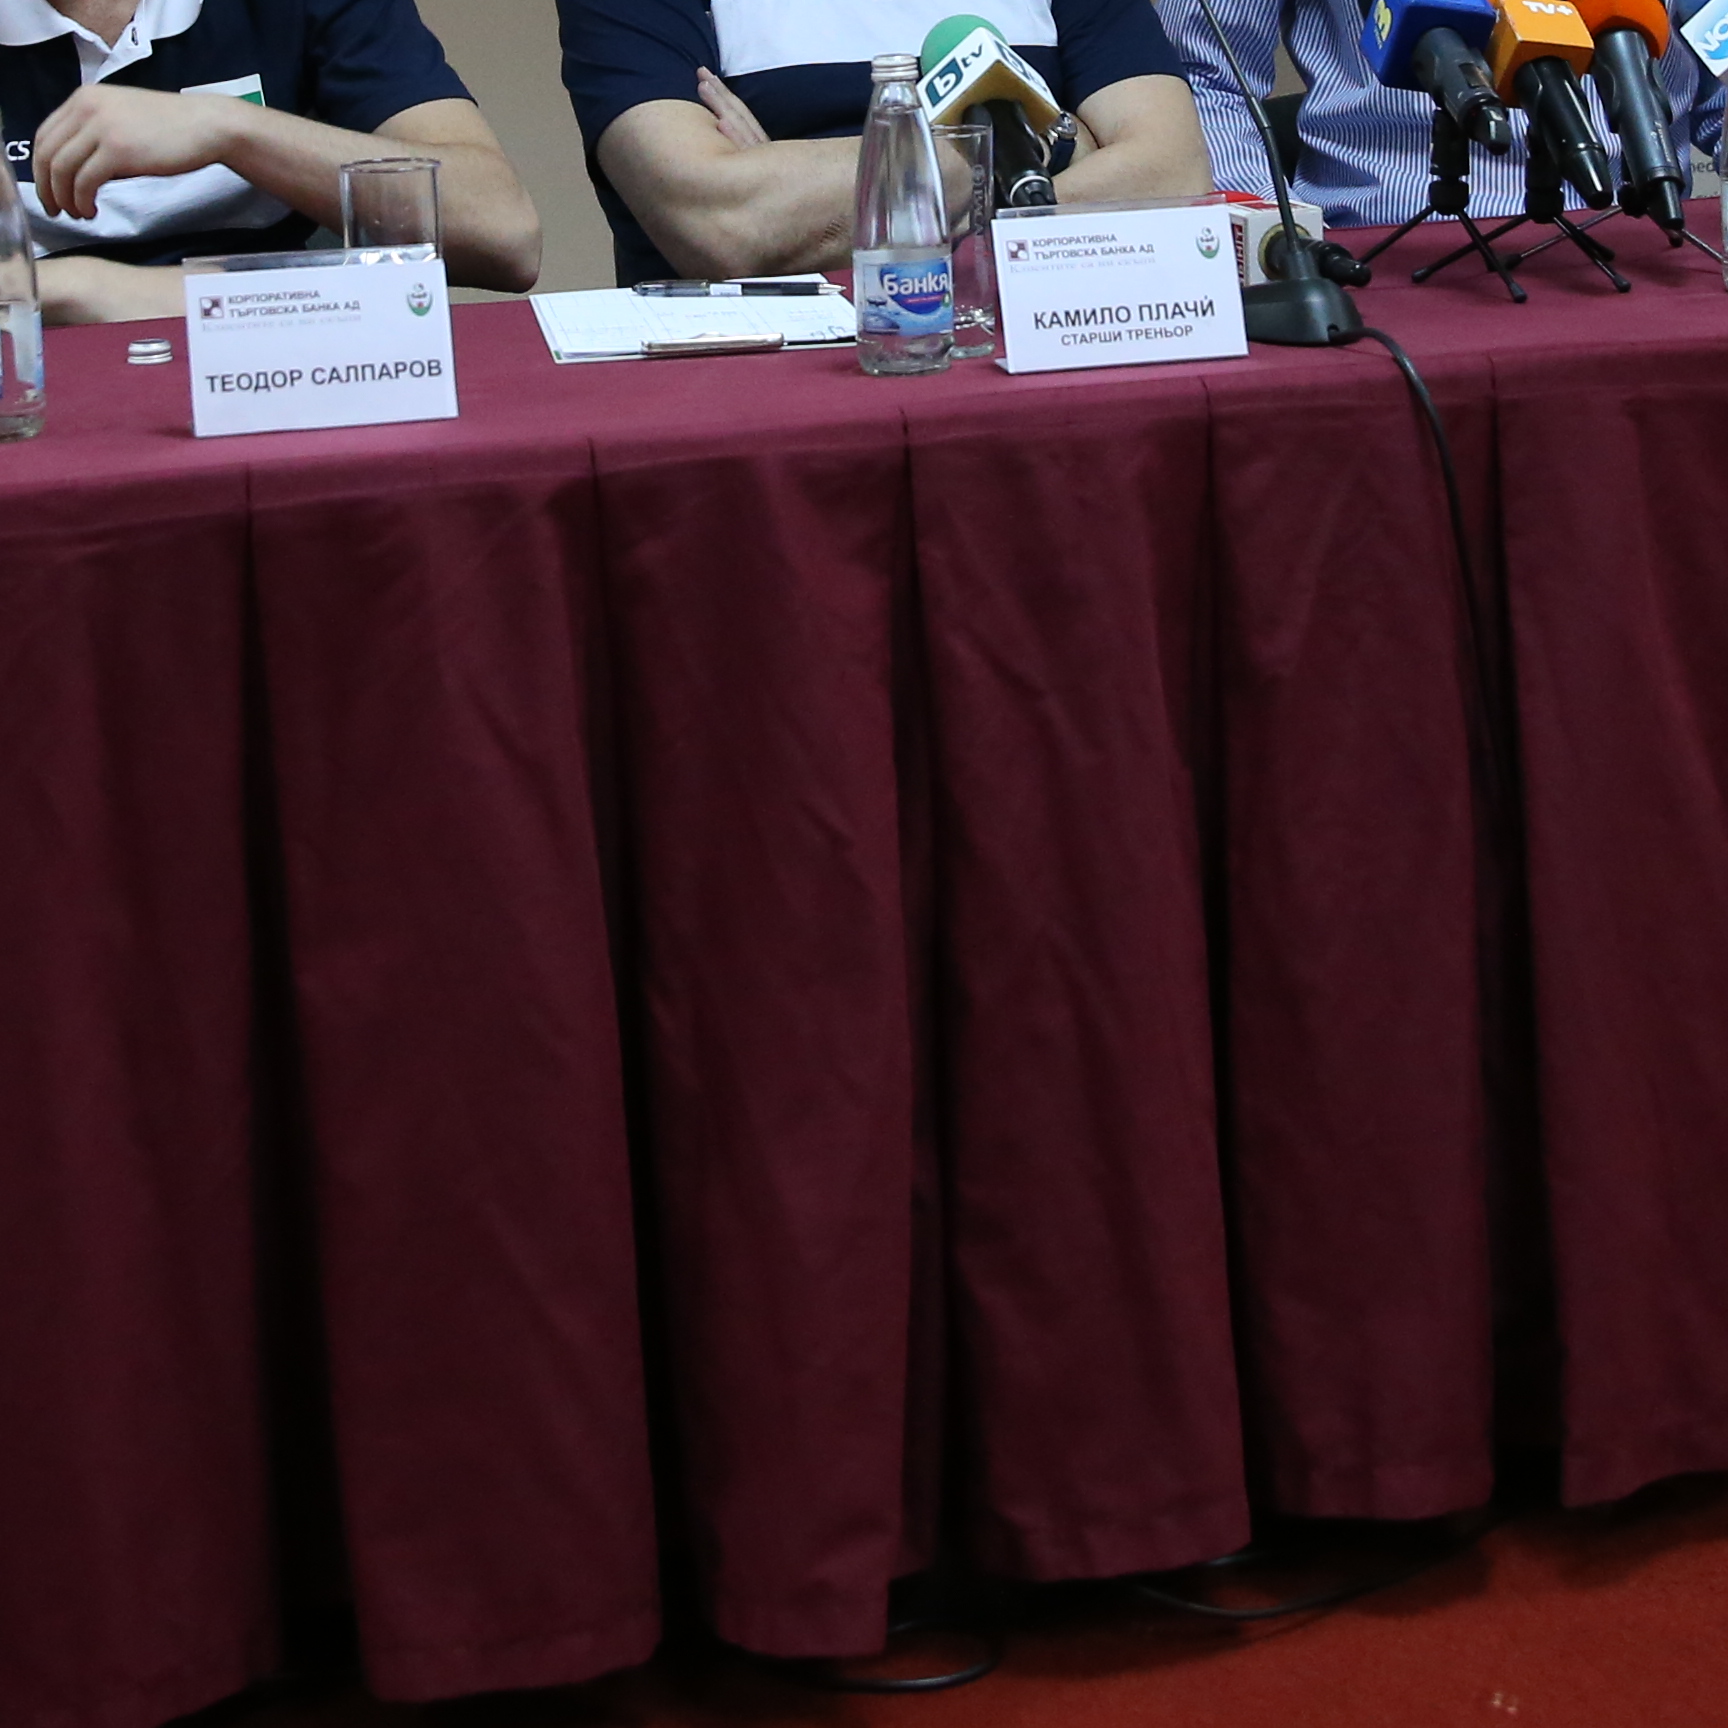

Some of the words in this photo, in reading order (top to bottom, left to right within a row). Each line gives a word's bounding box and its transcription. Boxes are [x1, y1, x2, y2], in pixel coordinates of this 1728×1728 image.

[1032, 234, 1117, 248] КОРПОРАТИВНА
[1034, 246, 1099, 261] ТЪРГОВСКА
[1101, 244, 1136, 256] БАНКА
[1138, 243, 1155, 255] АД
[228, 290, 320, 305] КОРПОРАТИВНА
[229, 304, 299, 318] ТЪРГОВСКА
[302, 302, 341, 314] БАНКА
[344, 300, 361, 312] АД
[1033, 305, 1132, 330] КАМИЛО
[1061, 330, 1123, 346] СТАРШИ
[1127, 325, 1193, 341] ТРЕНЬОР
[206, 368, 303, 393] ТЕОДОР
[311, 359, 443, 385] САЛПАРОВ
